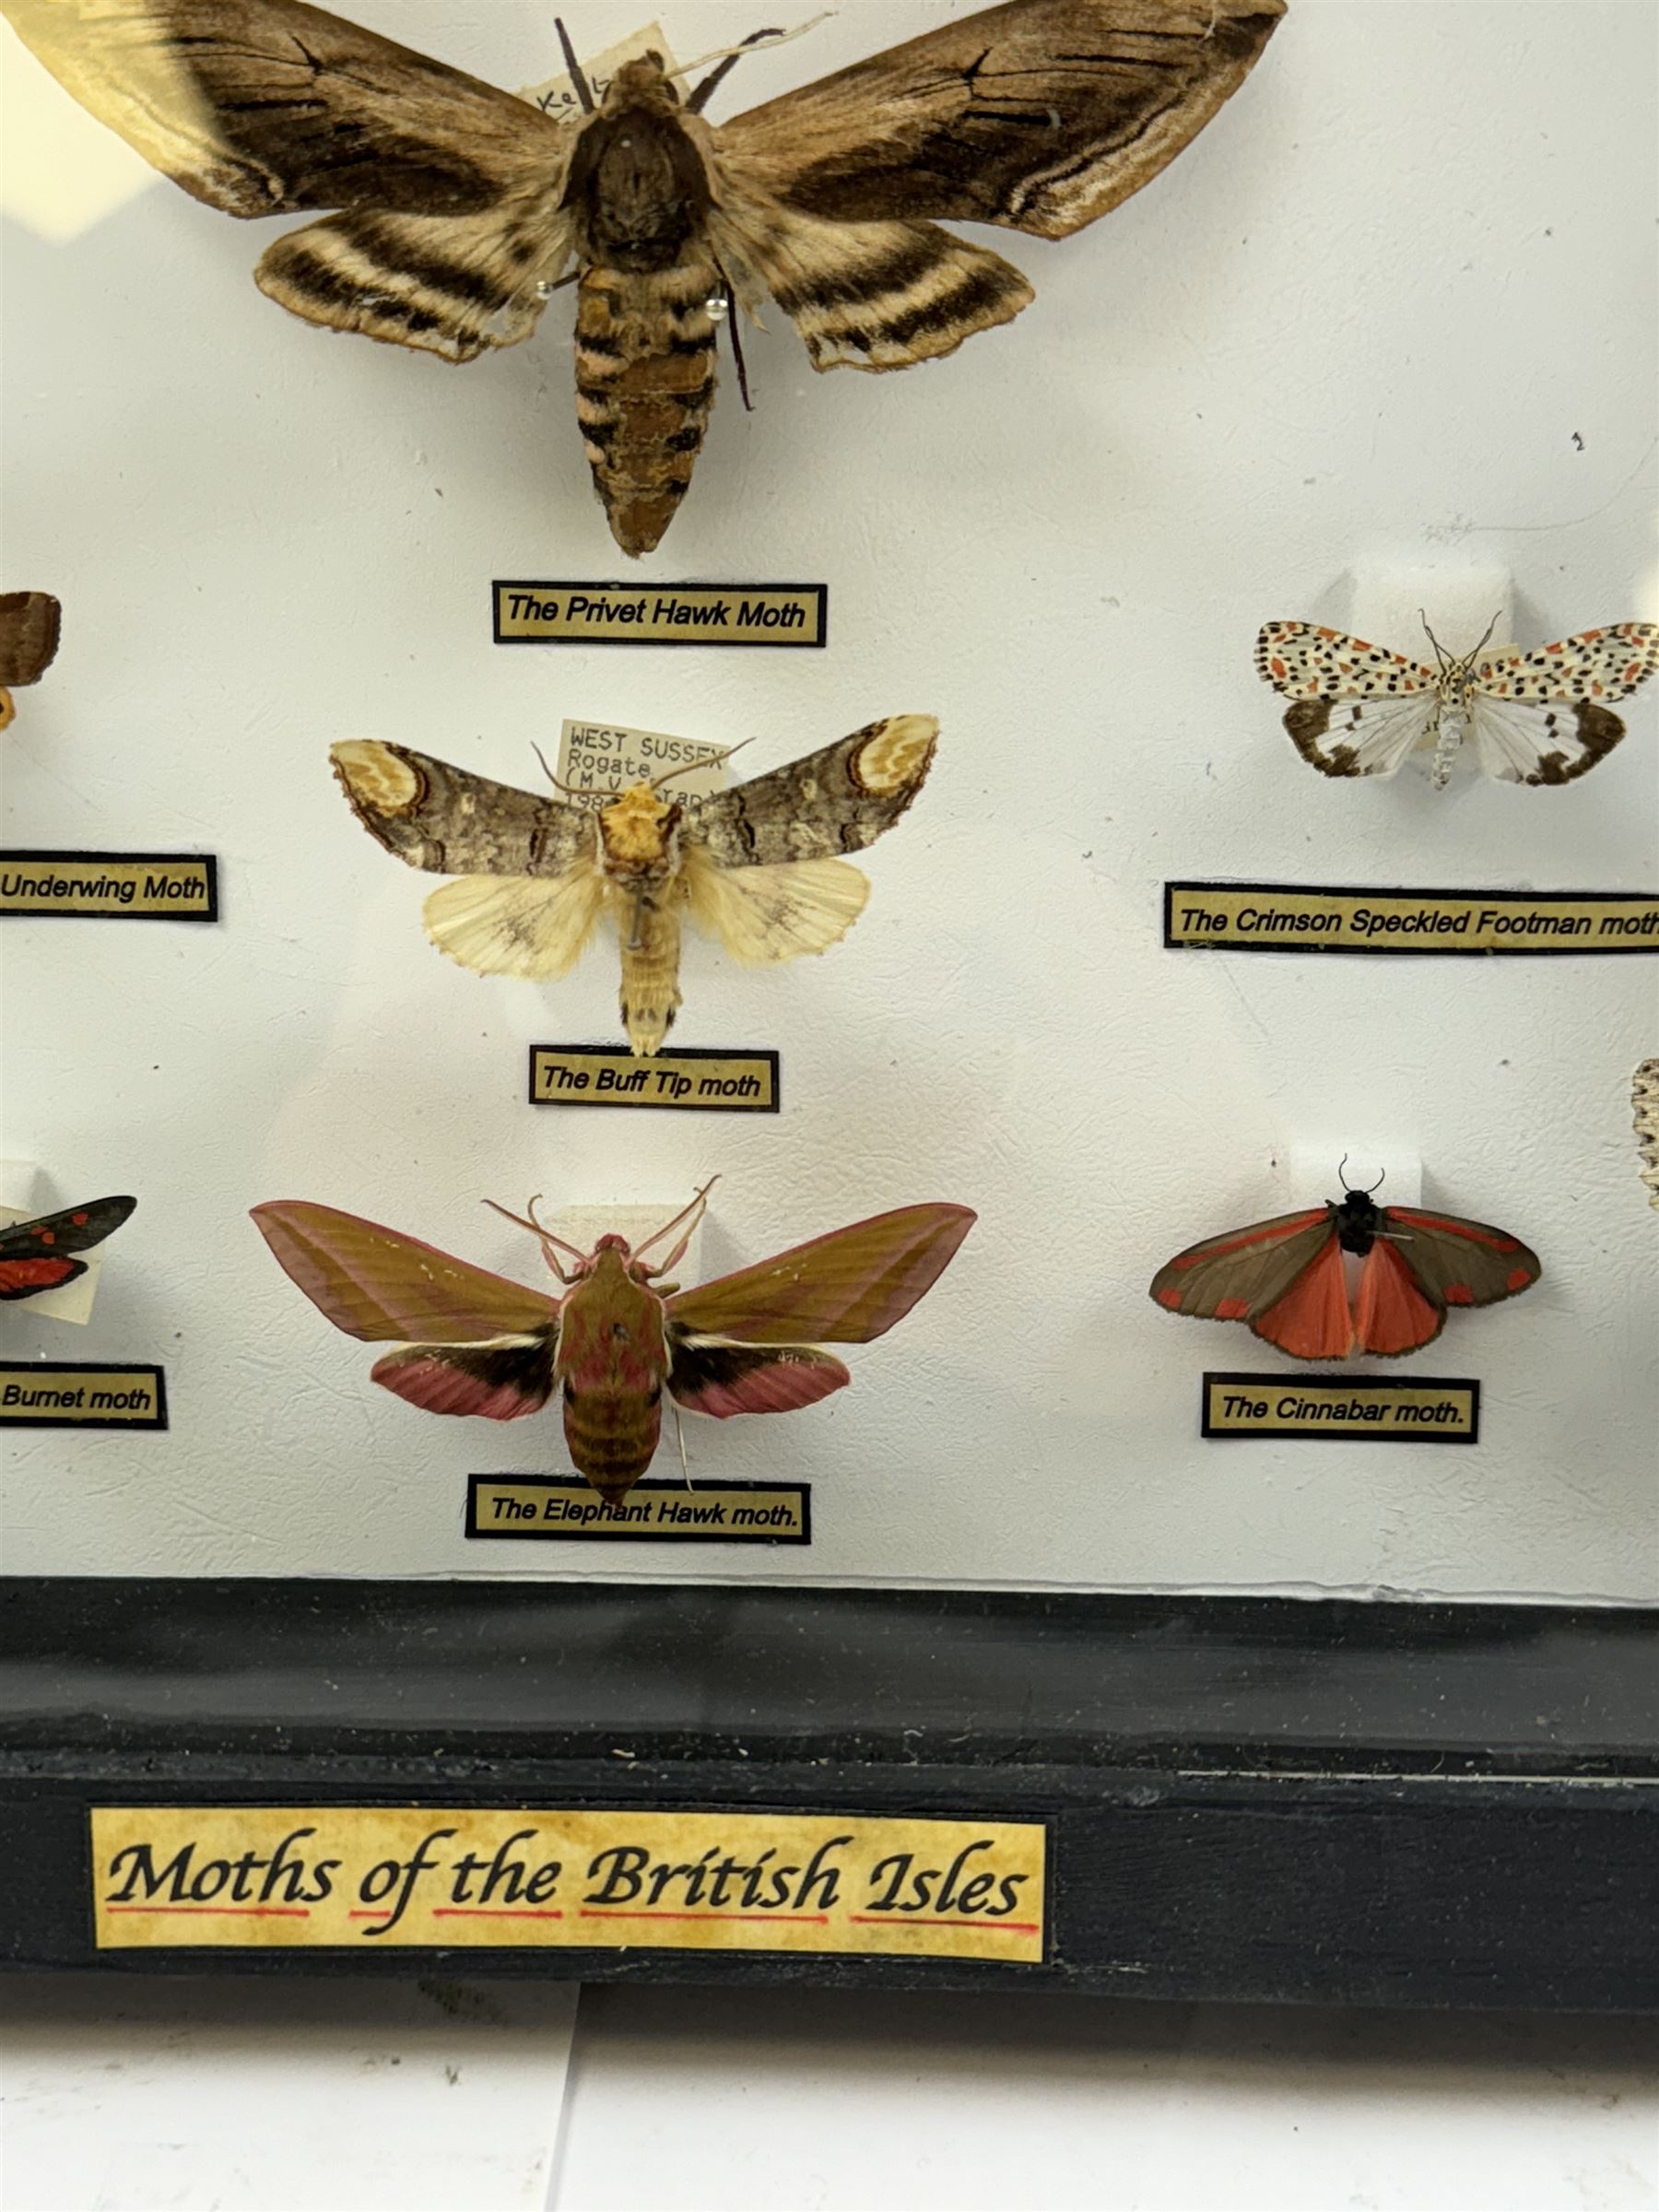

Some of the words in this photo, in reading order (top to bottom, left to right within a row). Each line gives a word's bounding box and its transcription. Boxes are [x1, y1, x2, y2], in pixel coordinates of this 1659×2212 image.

[508, 594, 558, 620] The
[566, 597, 646, 624] Privet
[652, 599, 732, 626] Hawk
[736, 601, 806, 628] Moth
[569, 726, 628, 753] WEST
[640, 736, 724, 771] SUSSEX
[1, 874, 136, 903] Underwing
[143, 876, 205, 900] Moth
[1181, 909, 1228, 932] The
[1236, 909, 1342, 932] Crimson
[1349, 909, 1471, 937] Speckled
[1476, 911, 1592, 935] Footman
[544, 1065, 589, 1089] The
[595, 1068, 651, 1092] Buff
[655, 1071, 692, 1099] Tip
[699, 1075, 761, 1097] moth
[2, 1384, 85, 1407] Burnet
[89, 1389, 151, 1410] moth
[1223, 1396, 1267, 1418] The
[1277, 1397, 1391, 1421] Cinnabar
[1394, 1402, 1465, 1423] moth.
[492, 1498, 536, 1519] The
[544, 1499, 652, 1525] Elephant
[657, 1502, 724, 1525] Hawk
[732, 1505, 798, 1527] moth.
[105, 1827, 342, 1903] Moths
[359, 1828, 459, 1936] of
[451, 1829, 562, 1904] the
[582, 1835, 855, 1910] British
[865, 1840, 1030, 1916] Isles
